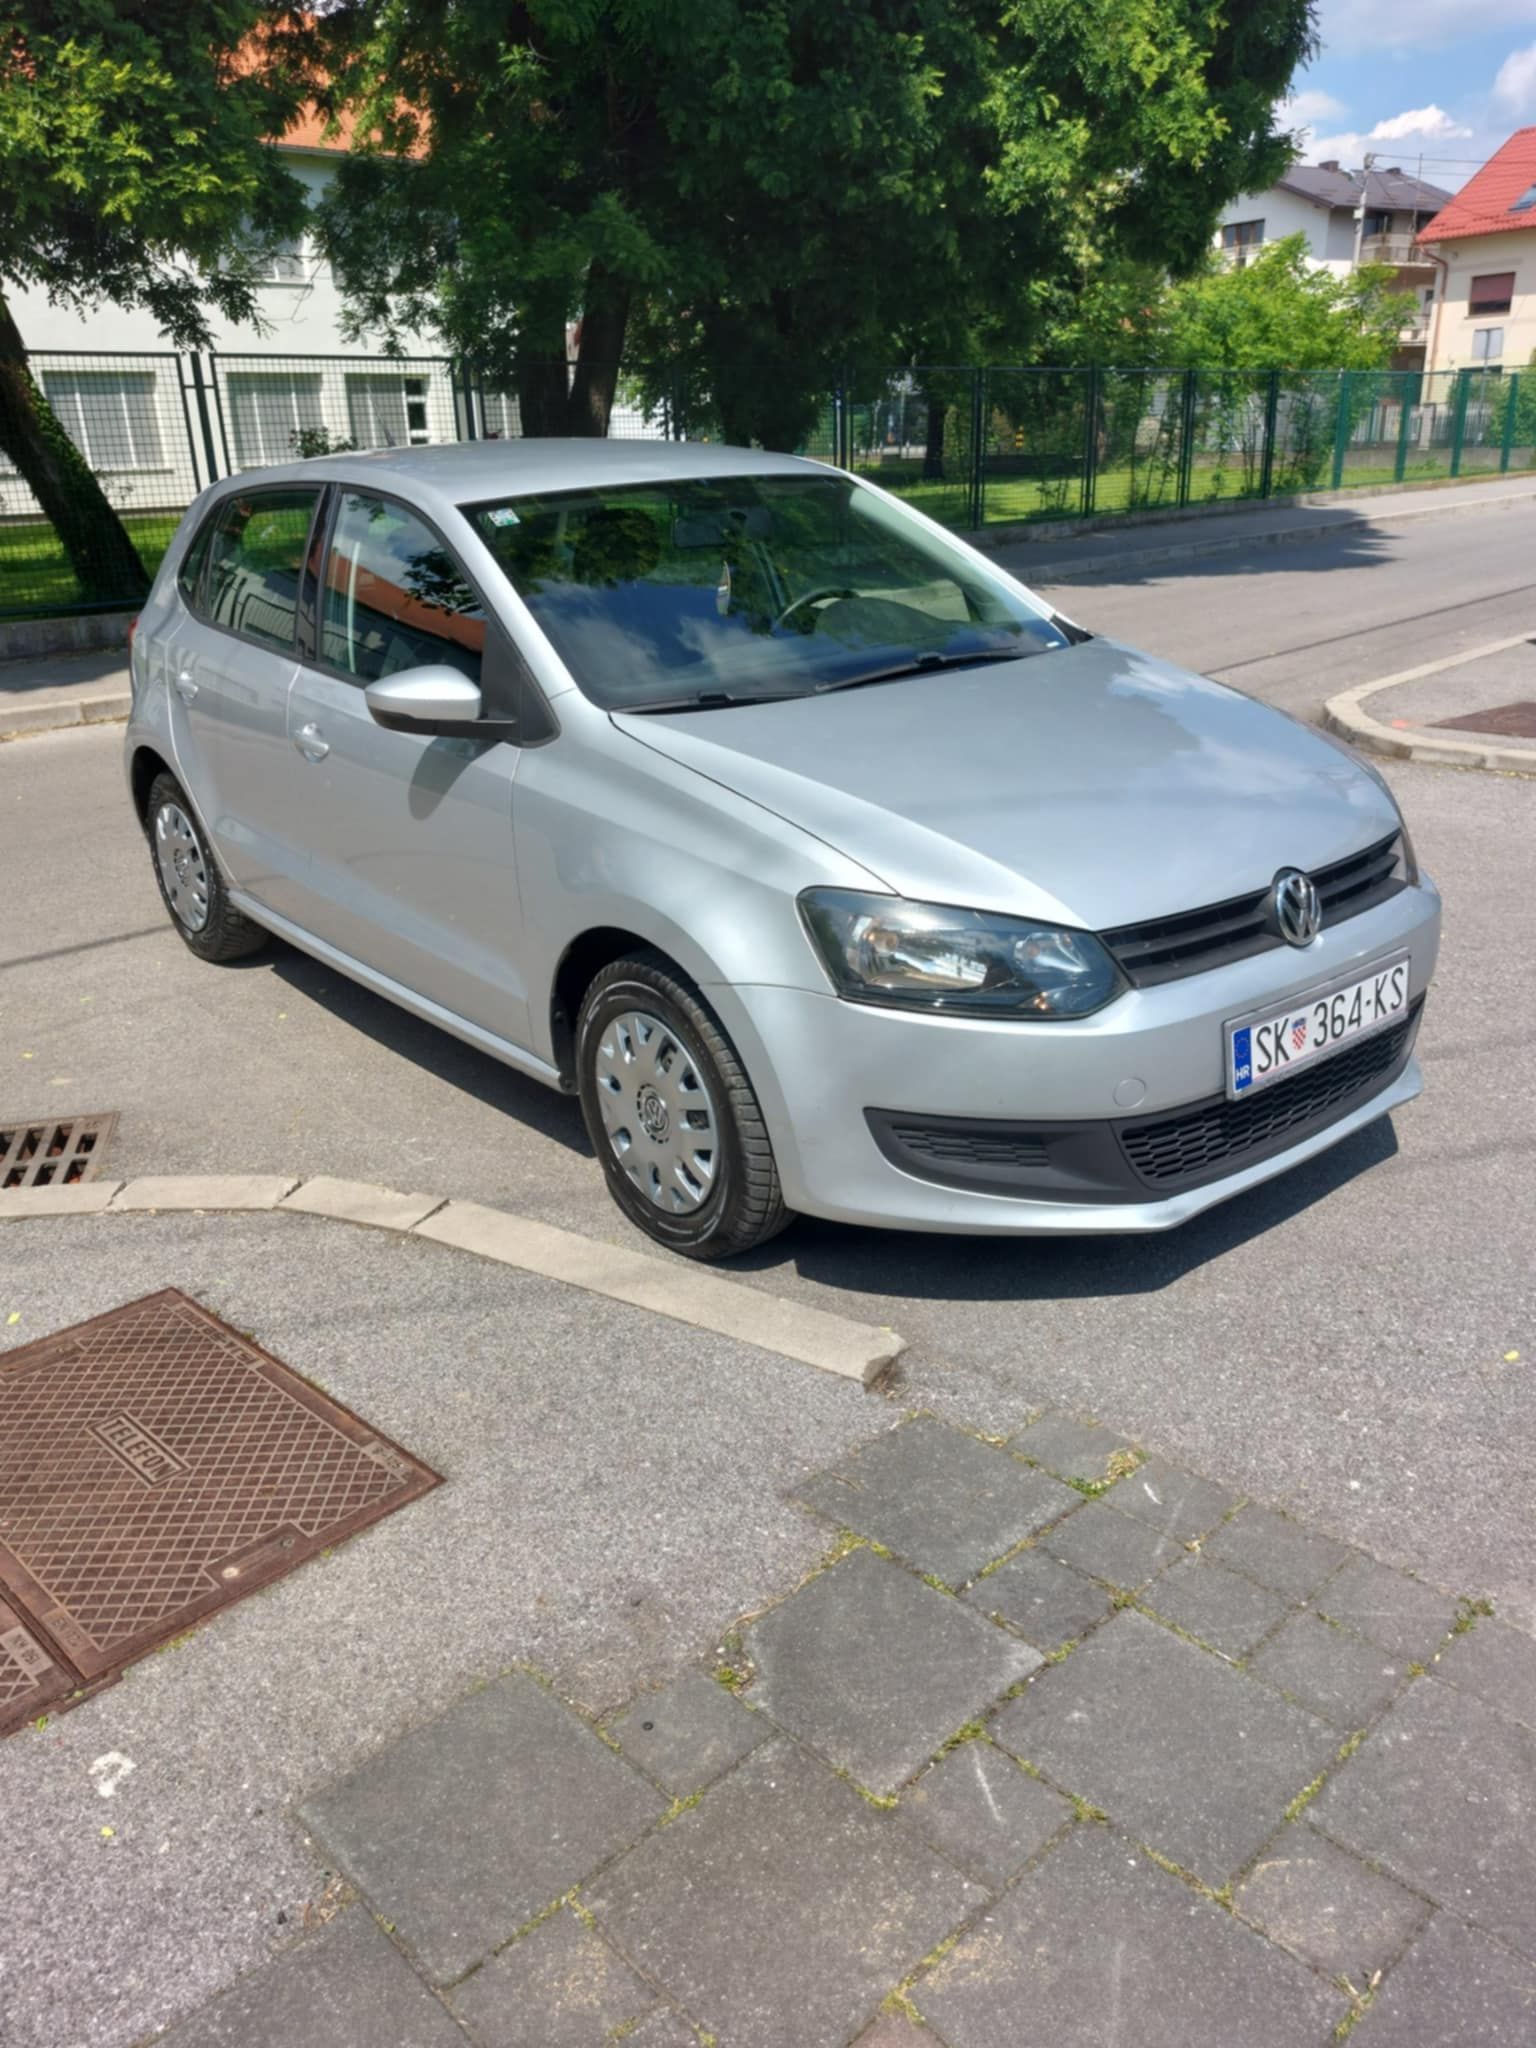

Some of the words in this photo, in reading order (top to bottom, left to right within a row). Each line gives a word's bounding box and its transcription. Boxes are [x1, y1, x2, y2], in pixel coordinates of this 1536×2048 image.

[1277, 872, 1321, 945] VW
[1256, 1017, 1290, 1073] SK
[1313, 967, 1404, 1047] 364-KS
[1236, 1064, 1250, 1082] HR
[101, 1419, 177, 1479] TELEFON
